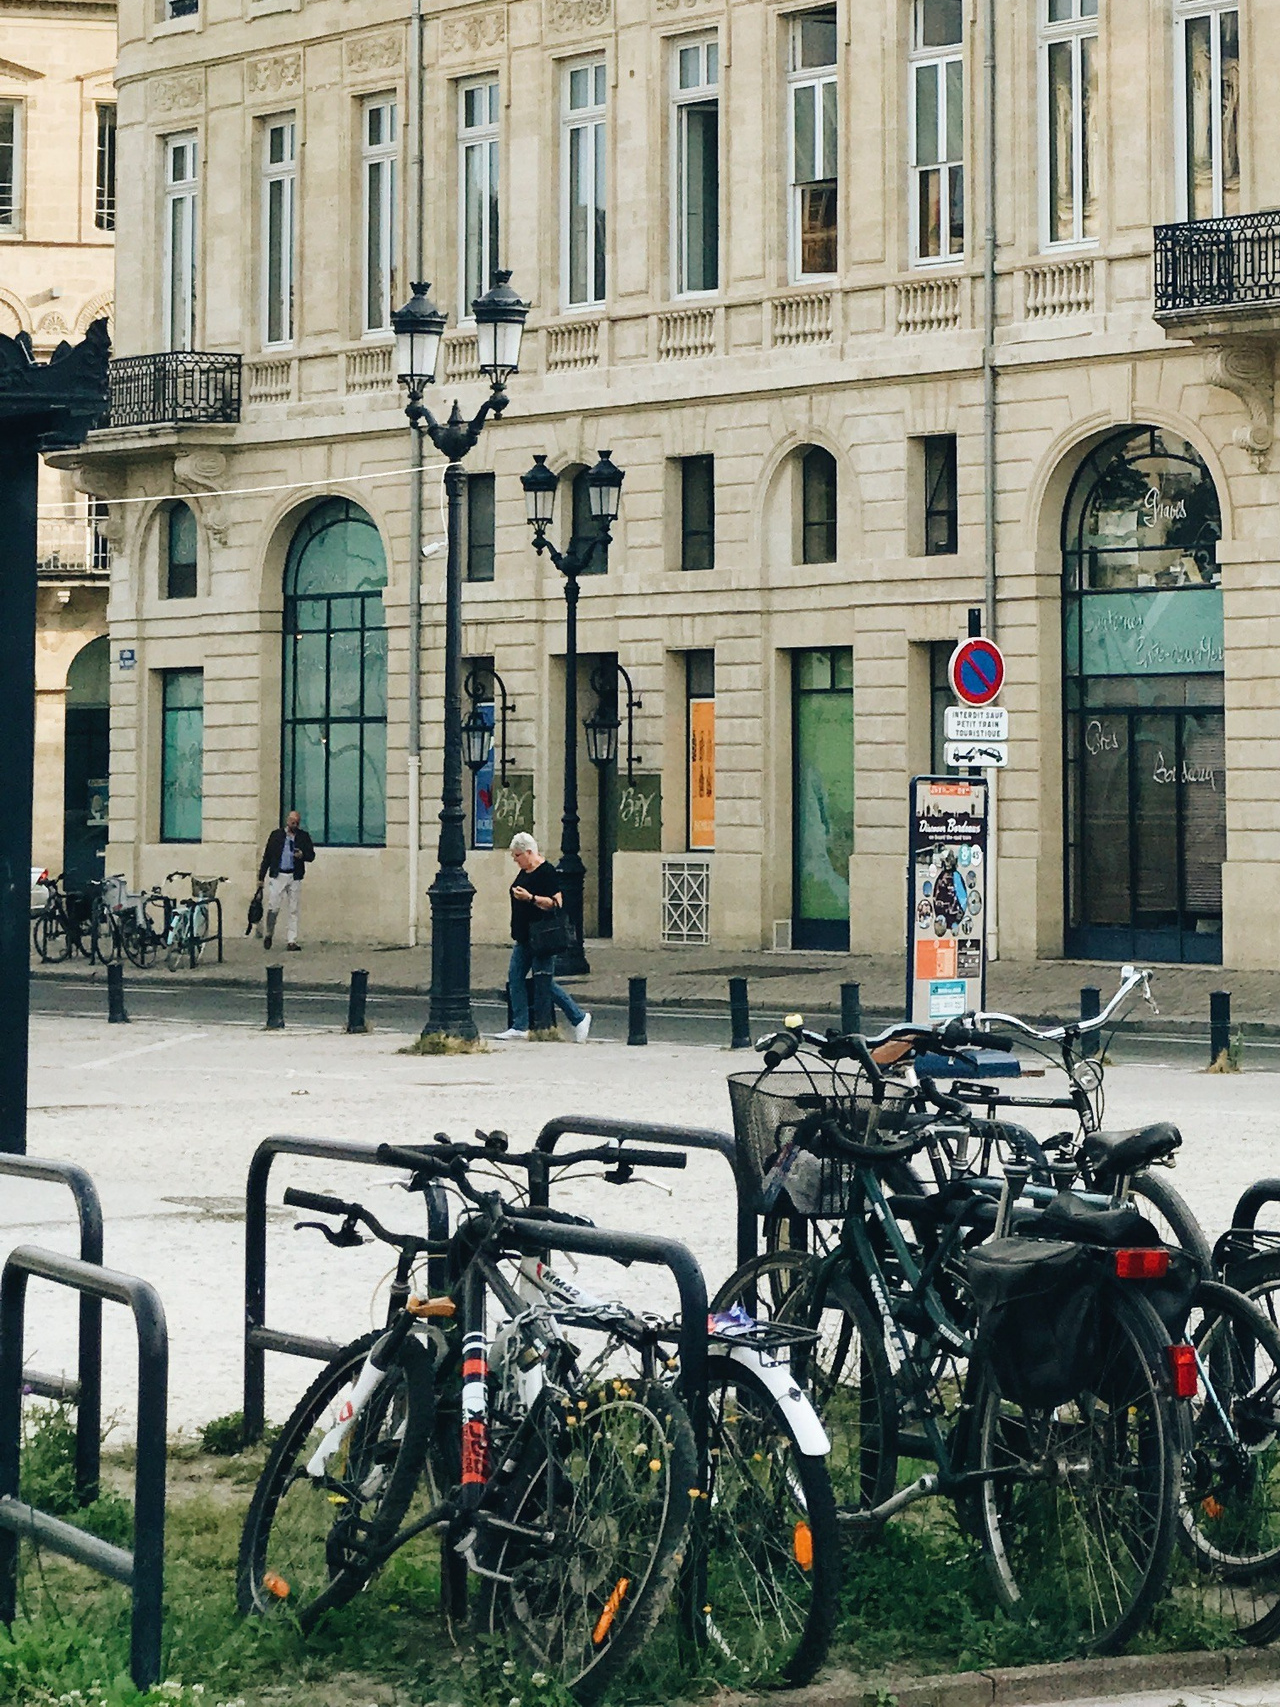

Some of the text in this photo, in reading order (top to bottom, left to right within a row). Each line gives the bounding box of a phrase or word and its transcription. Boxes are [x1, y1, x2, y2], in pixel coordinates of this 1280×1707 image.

[952, 711, 1003, 719] INTERDIT SAUF
[957, 720, 1000, 728] PETIT TRAIN
[955, 729, 1001, 738] TOURISTIQUE
[543, 1270, 580, 1299] MM42
